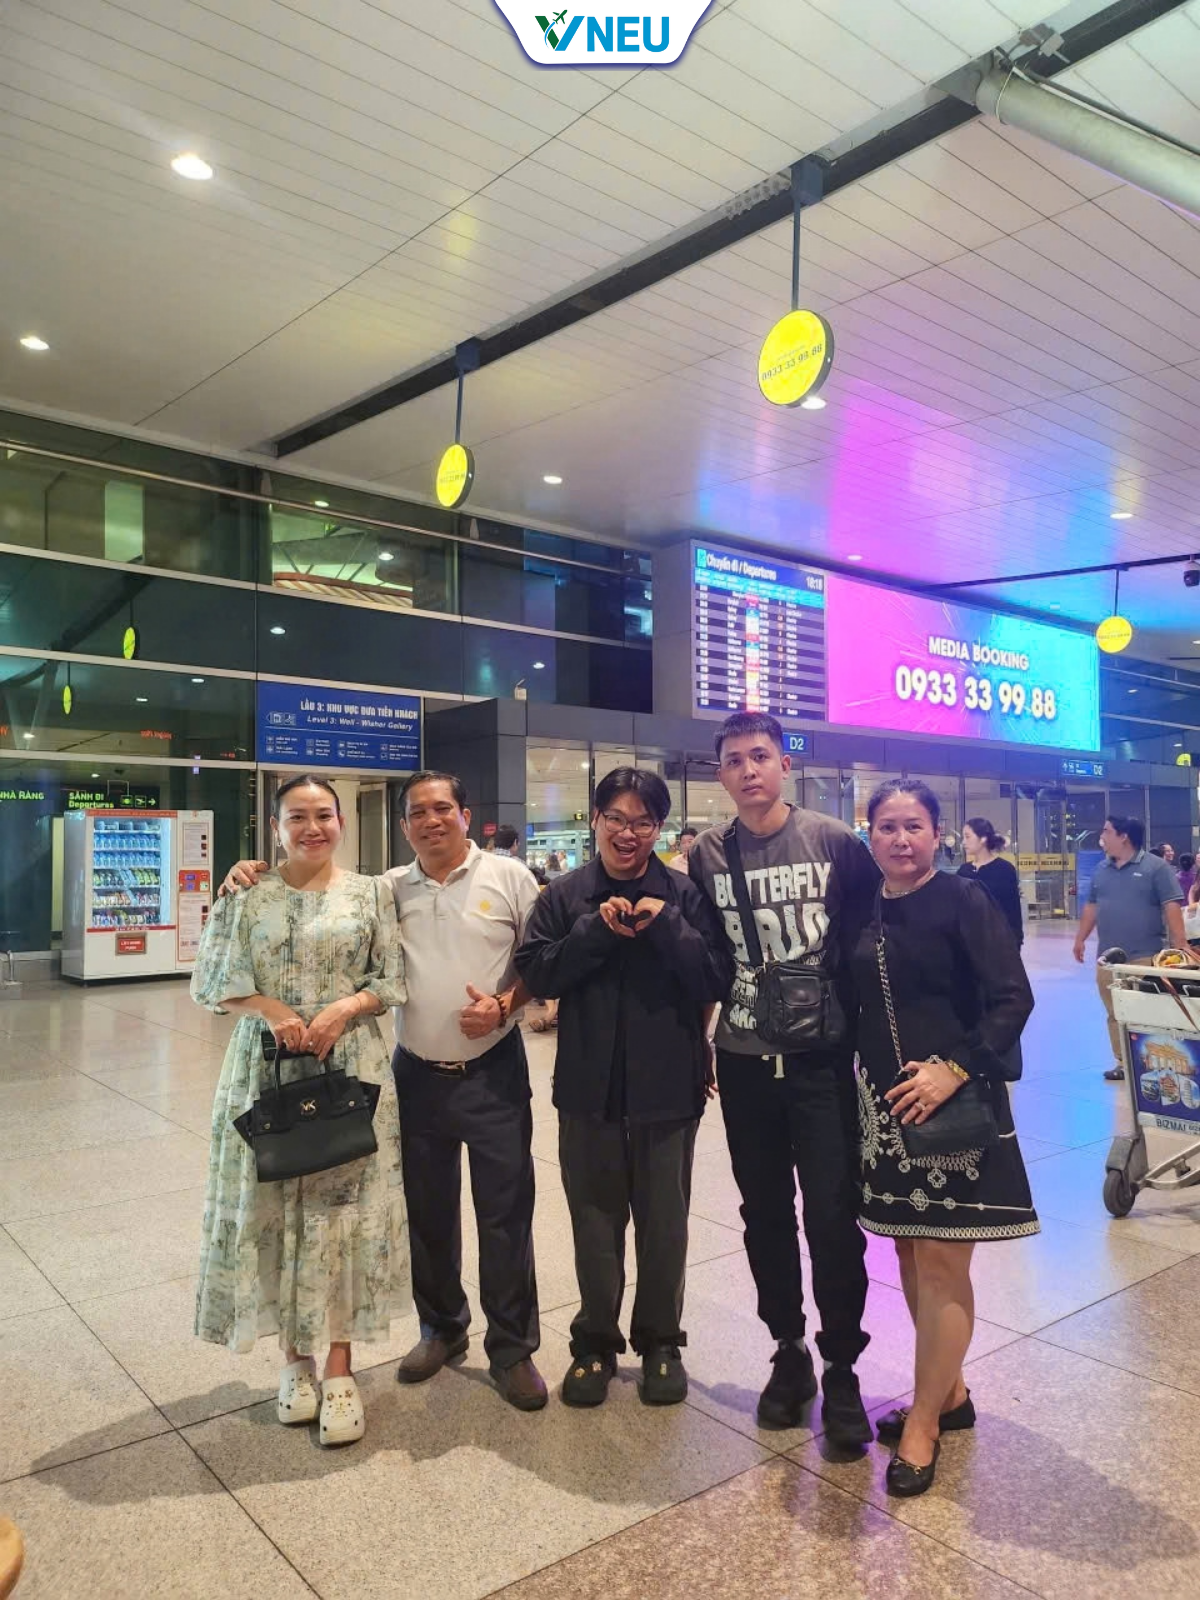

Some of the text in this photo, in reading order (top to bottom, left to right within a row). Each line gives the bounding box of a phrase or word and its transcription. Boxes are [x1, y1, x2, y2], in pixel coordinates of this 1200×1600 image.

[929, 636, 1030, 671] MEDIA BOOKING
[895, 665, 1057, 720] 0933 33 99 88
[317, 703, 325, 712] 3:
[307, 715, 328, 724] Level
[789, 737, 804, 750] D2
[68, 801, 114, 809] Departures
